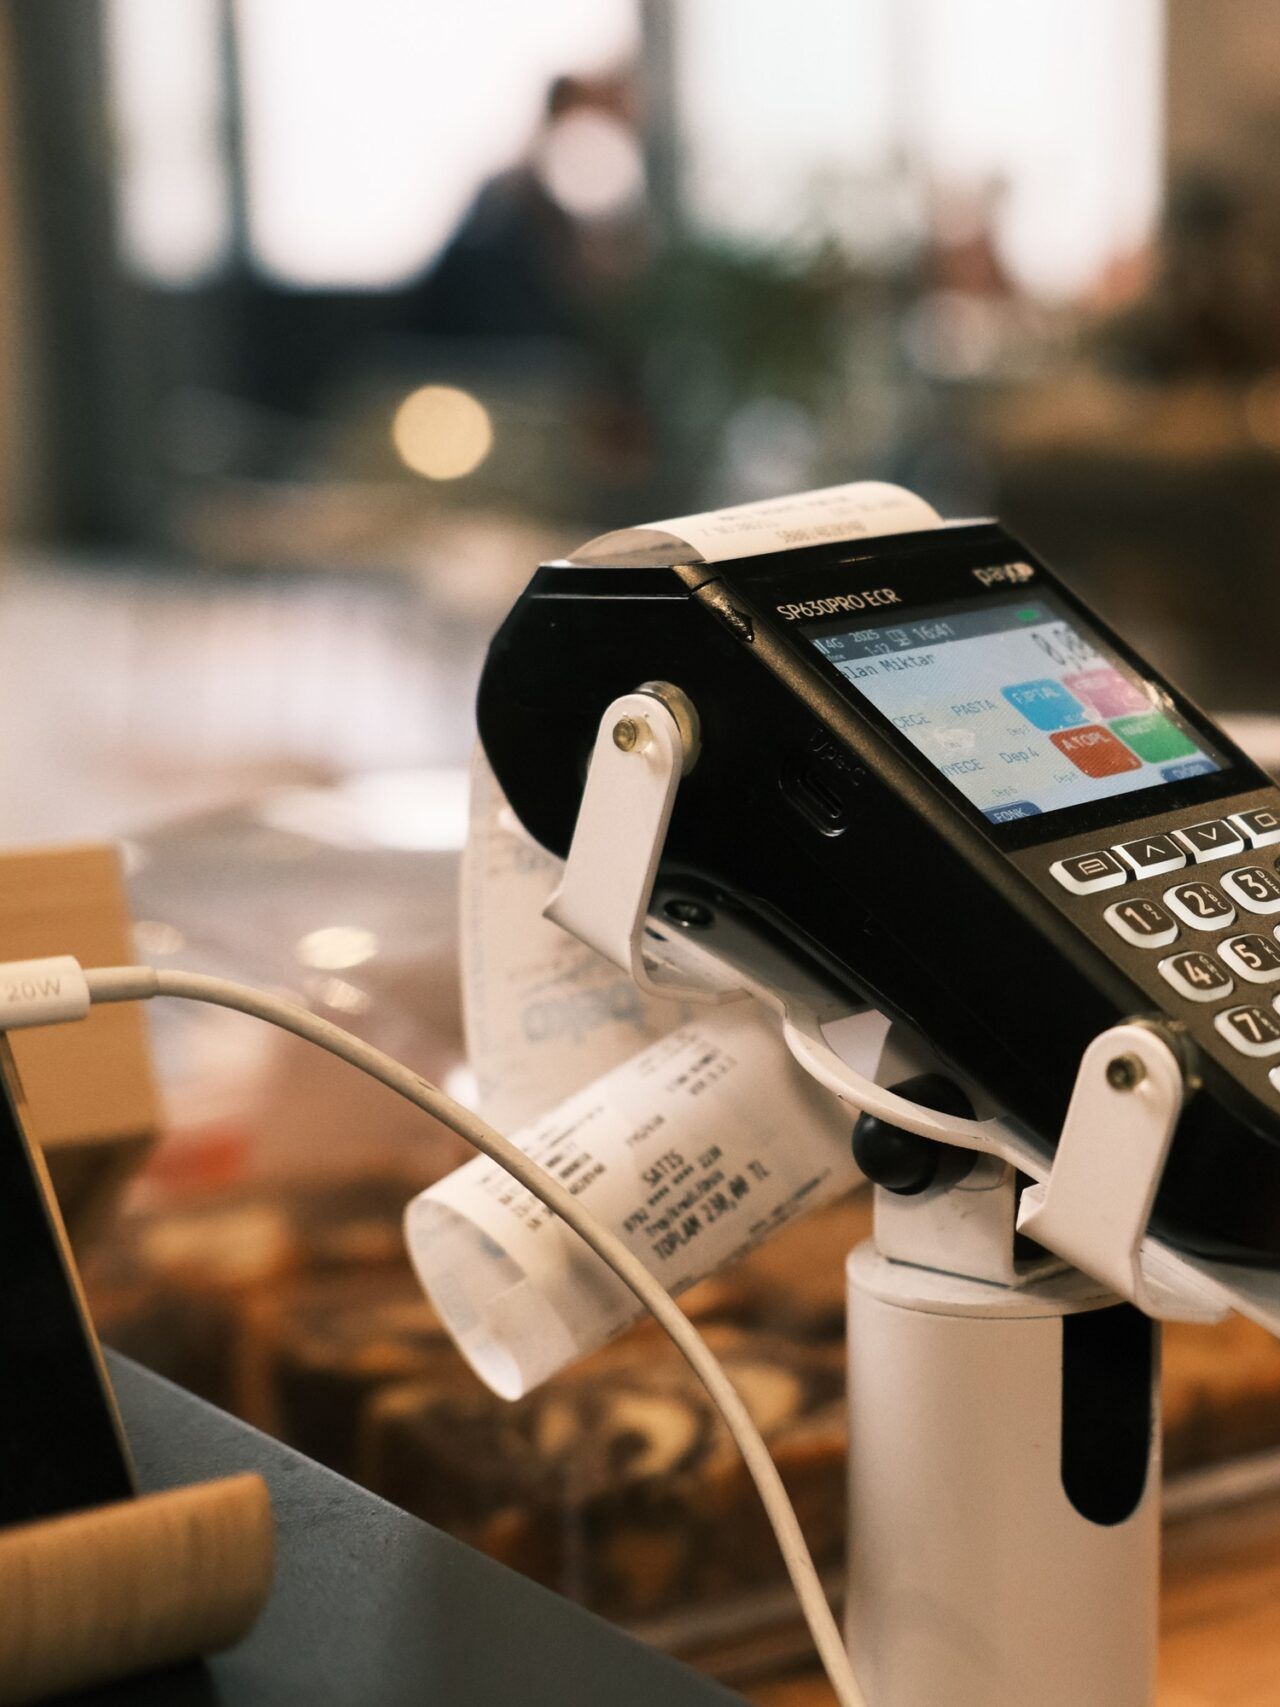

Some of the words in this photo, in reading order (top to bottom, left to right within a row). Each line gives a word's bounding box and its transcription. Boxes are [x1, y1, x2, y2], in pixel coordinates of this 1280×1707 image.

[776, 594, 866, 621] SP630PRO
[861, 588, 902, 607] ECR
[825, 638, 844, 650] 4G
[848, 629, 880, 643] 2025
[912, 623, 955, 641] 16:41
[879, 654, 935, 673] Miktar
[951, 699, 998, 717] PASTA
[999, 750, 1029, 764] Dep
[993, 807, 1026, 824] FONK
[1238, 873, 1268, 899] 3
[1255, 870, 1280, 895] DEF
[1183, 890, 1215, 916] 2
[1200, 886, 1227, 910] ABC
[1124, 906, 1152, 932] 1
[1234, 943, 1262, 969] 5
[1184, 960, 1212, 985] 4
[8, 978, 61, 1002] 20W
[1233, 1012, 1263, 1041] 7
